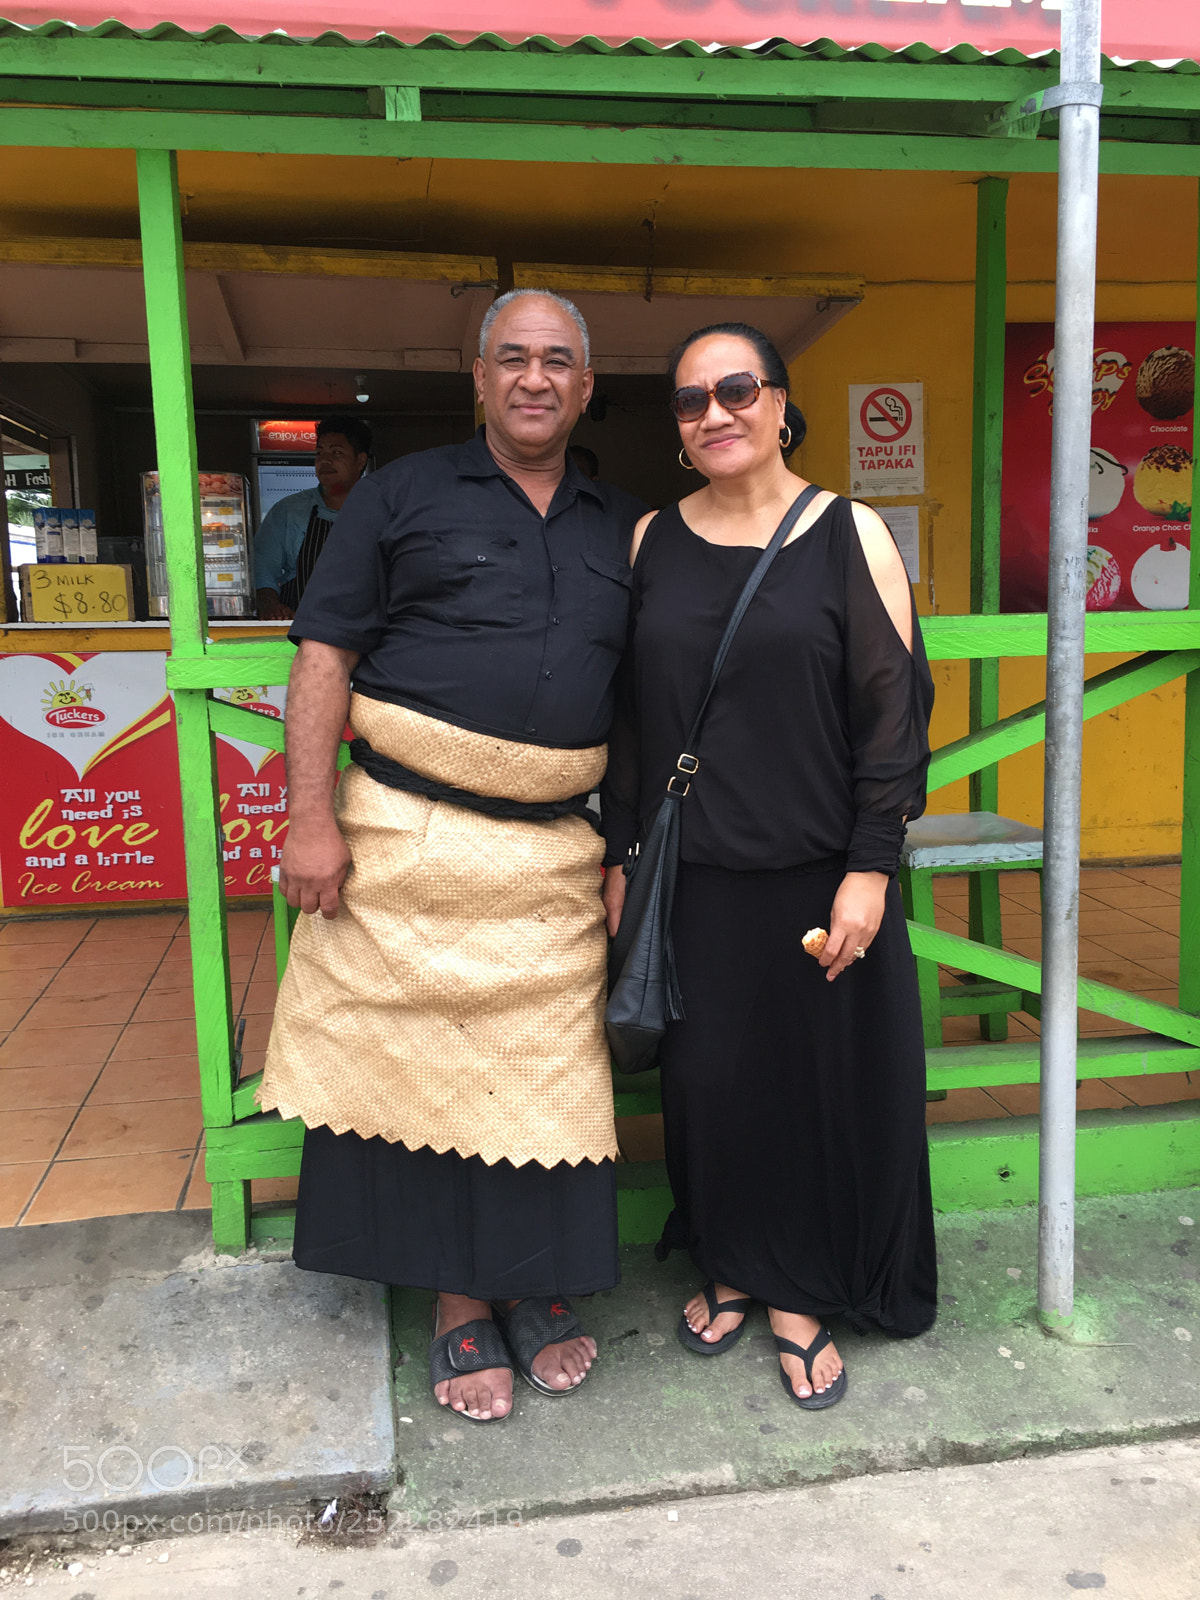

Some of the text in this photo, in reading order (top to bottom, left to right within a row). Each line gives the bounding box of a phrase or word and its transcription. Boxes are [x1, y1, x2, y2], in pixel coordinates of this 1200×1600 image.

[268, 430, 316, 442] enjoy ice
[1149, 425, 1188, 433] Chocolate
[857, 444, 916, 458] TAPU IFI
[858, 458, 915, 471] TAPAKA
[1132, 524, 1160, 533] Orange
[33, 569, 95, 590] 3 MILK
[53, 591, 127, 620] $8.80
[49, 707, 100, 724] Tuckers
[60, 788, 141, 804] All you
[236, 783, 270, 798] All
[61, 804, 143, 821] need is
[236, 798, 287, 816] need
[19, 798, 159, 850] love
[25, 850, 155, 869] and a little
[249, 847, 263, 858] a
[18, 870, 164, 897] Ice Cream
